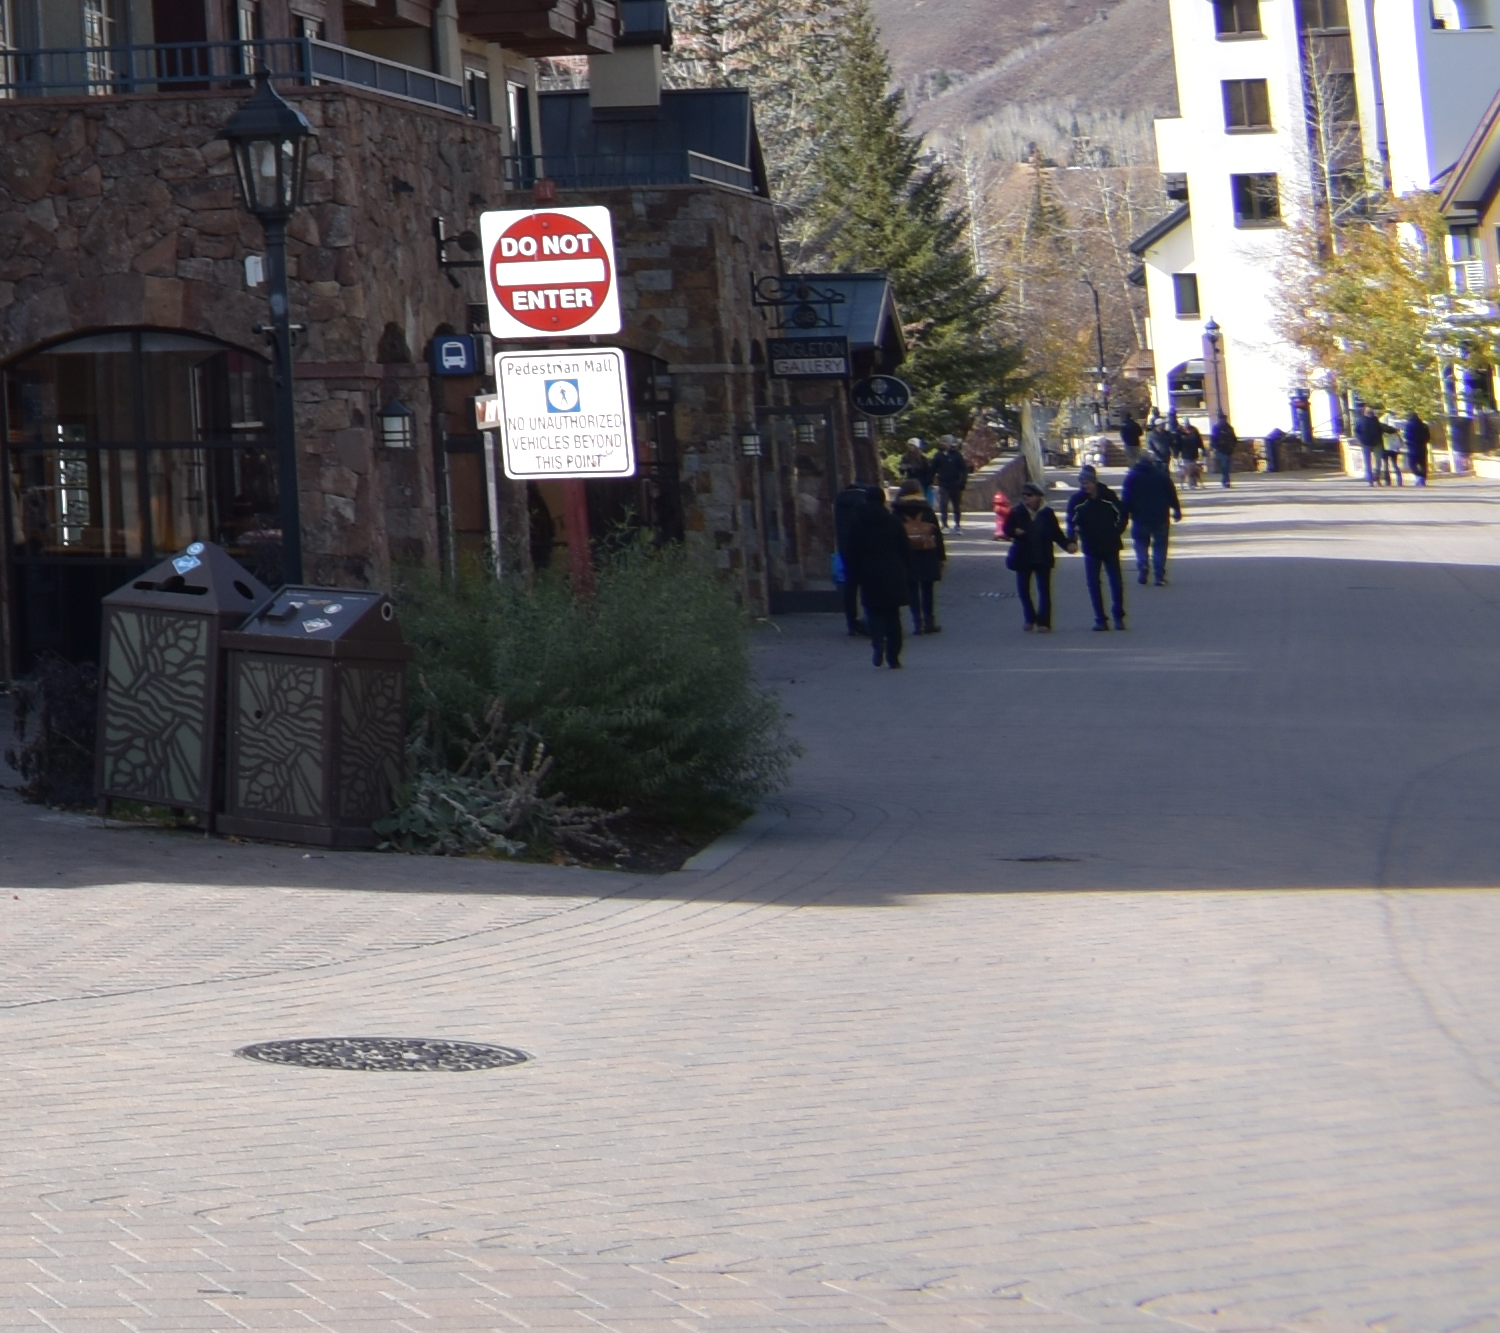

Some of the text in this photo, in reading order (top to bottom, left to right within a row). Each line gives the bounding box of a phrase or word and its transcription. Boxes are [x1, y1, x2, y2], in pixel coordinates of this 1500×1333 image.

[501, 233, 593, 257] DO NOT
[512, 288, 594, 310] ENTER
[772, 341, 844, 358] SINGLETON
[507, 359, 612, 376] Pedestrian Mall
[776, 359, 841, 374] GALLERY
[508, 414, 621, 431] NO UNAUTHORIZED
[512, 434, 621, 450] VEHICLES BEYOND
[535, 454, 604, 469] THIS POINT
